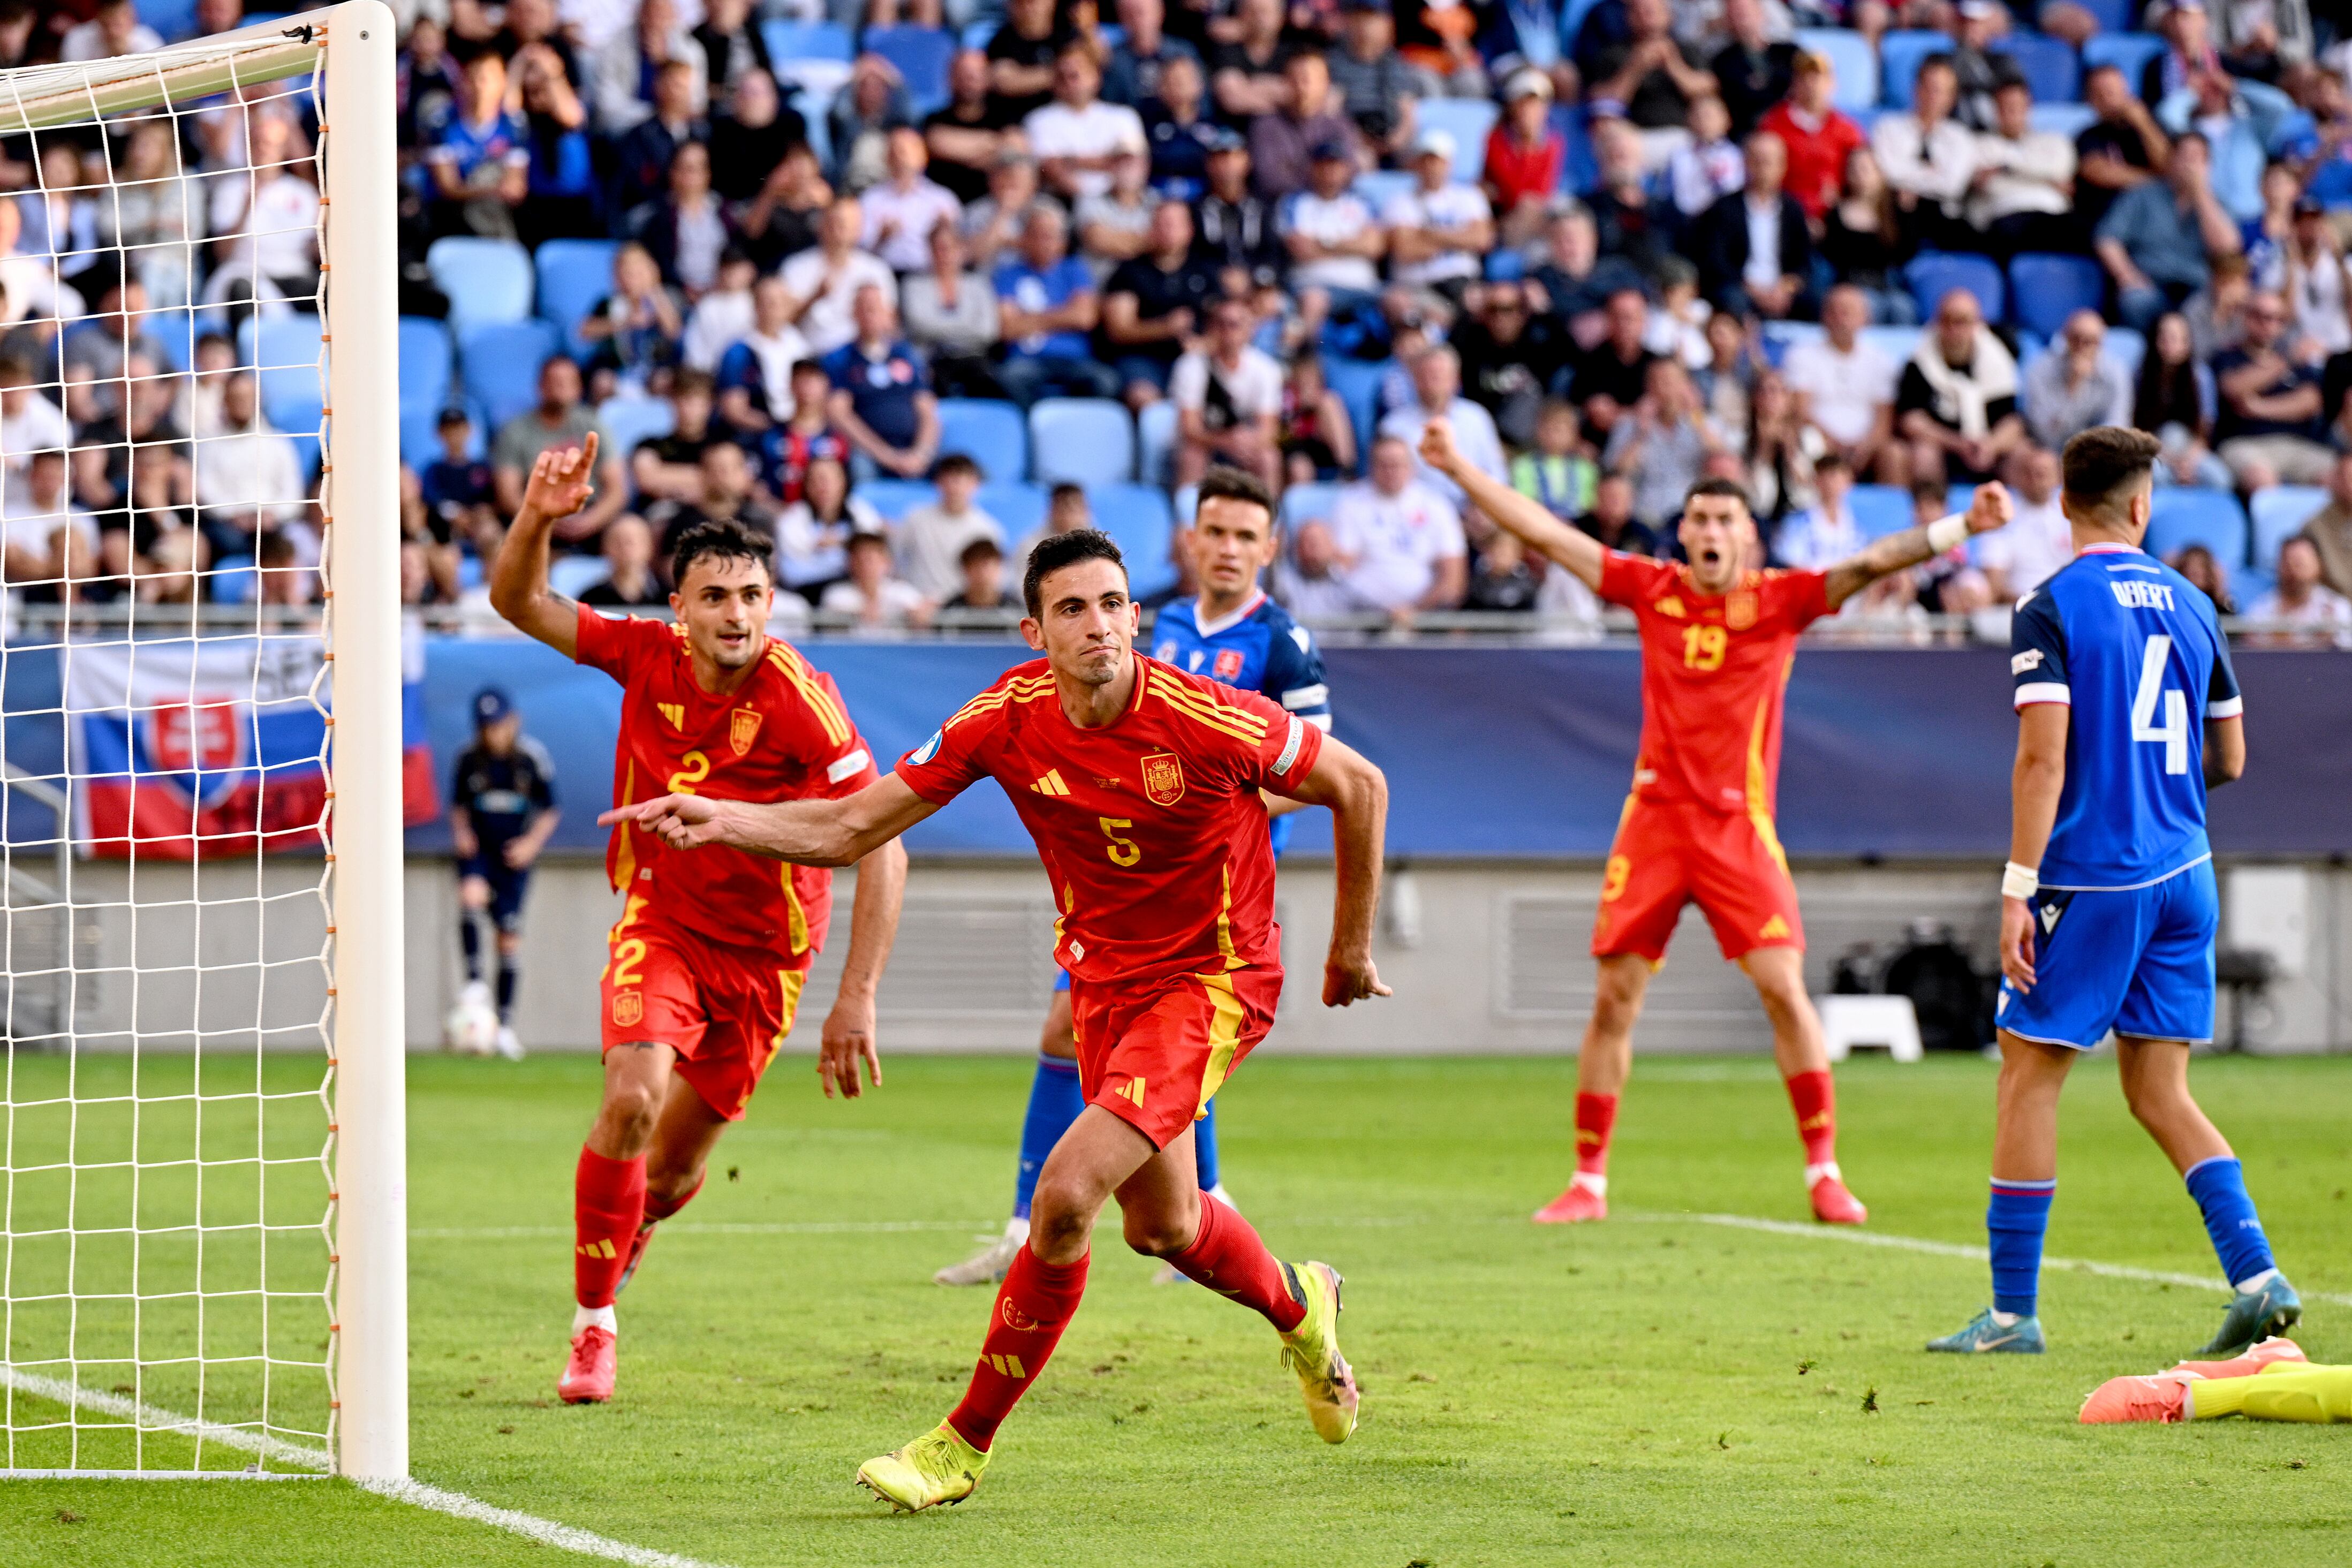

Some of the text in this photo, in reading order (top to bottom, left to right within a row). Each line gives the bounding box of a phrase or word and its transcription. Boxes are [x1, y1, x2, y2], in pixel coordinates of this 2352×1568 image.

[2110, 580, 2175, 611] OBERT
[1681, 623, 1728, 671] 19
[2131, 634, 2188, 775] 4
[667, 750, 710, 795] 2
[1099, 817, 1141, 867] 5
[614, 938, 646, 987] 2
